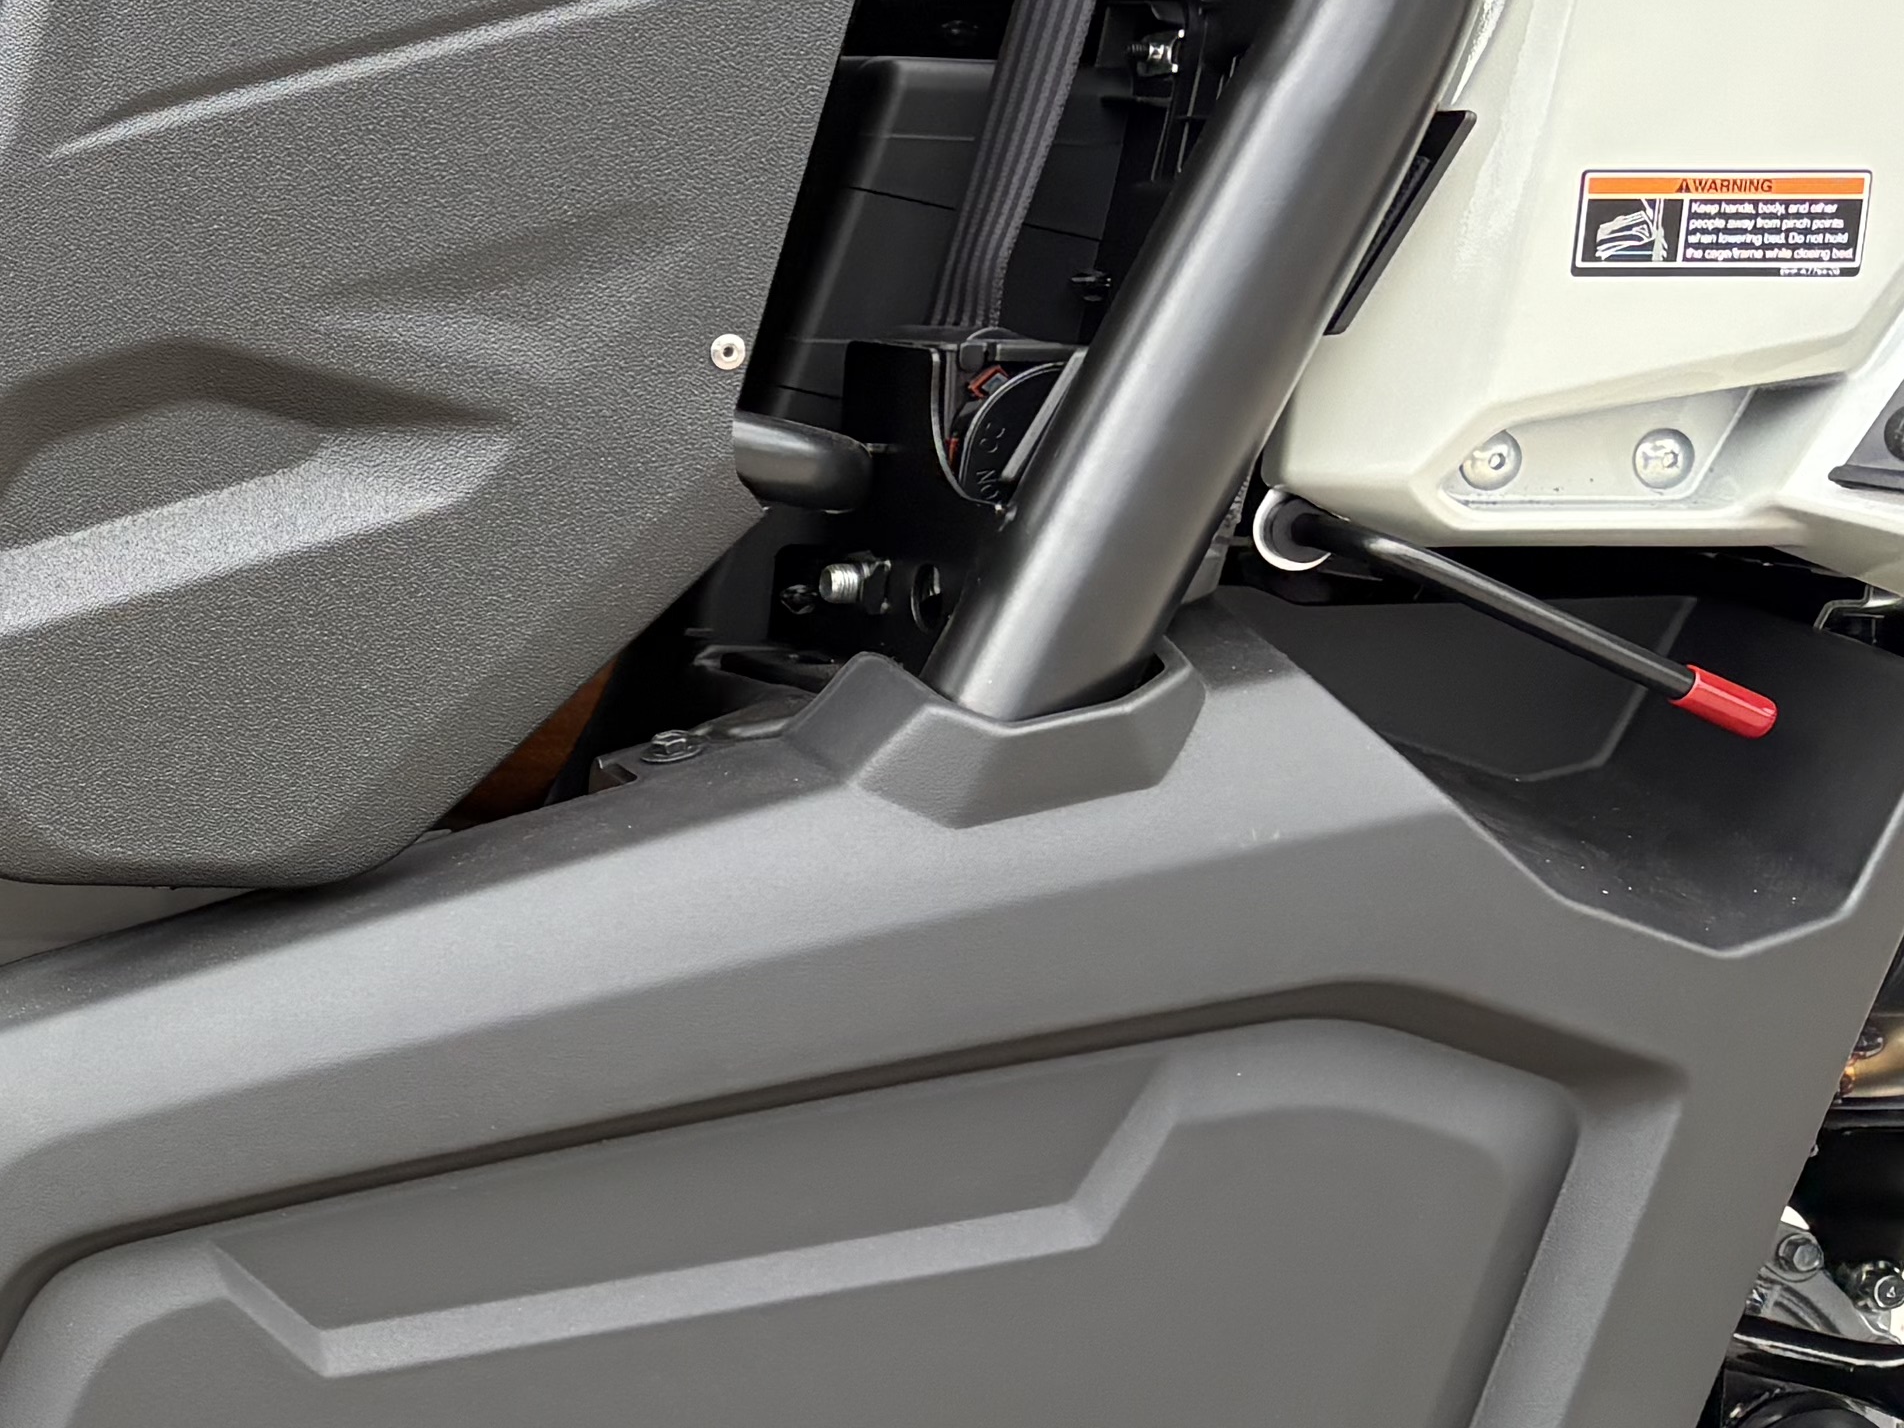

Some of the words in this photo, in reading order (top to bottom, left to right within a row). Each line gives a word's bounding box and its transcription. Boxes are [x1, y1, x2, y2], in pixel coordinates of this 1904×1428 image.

[1693, 179, 1773, 193] WARNING
[1691, 202, 1720, 215] Keep
[1788, 202, 1809, 214] and
[1810, 202, 1838, 214] other
[1688, 217, 1726, 230] people
[1726, 218, 1755, 231] away
[1756, 217, 1781, 229] from
[1782, 217, 1811, 231] pinch
[1811, 218, 1845, 231] points
[1687, 232, 1718, 244] when
[1718, 232, 1763, 246] lowering
[1788, 232, 1805, 244] Do
[1805, 232, 1824, 244] not
[1824, 232, 1849, 244] hold
[1685, 248, 1704, 259] the
[1764, 248, 1793, 260] while
[1793, 248, 1831, 262] closing
